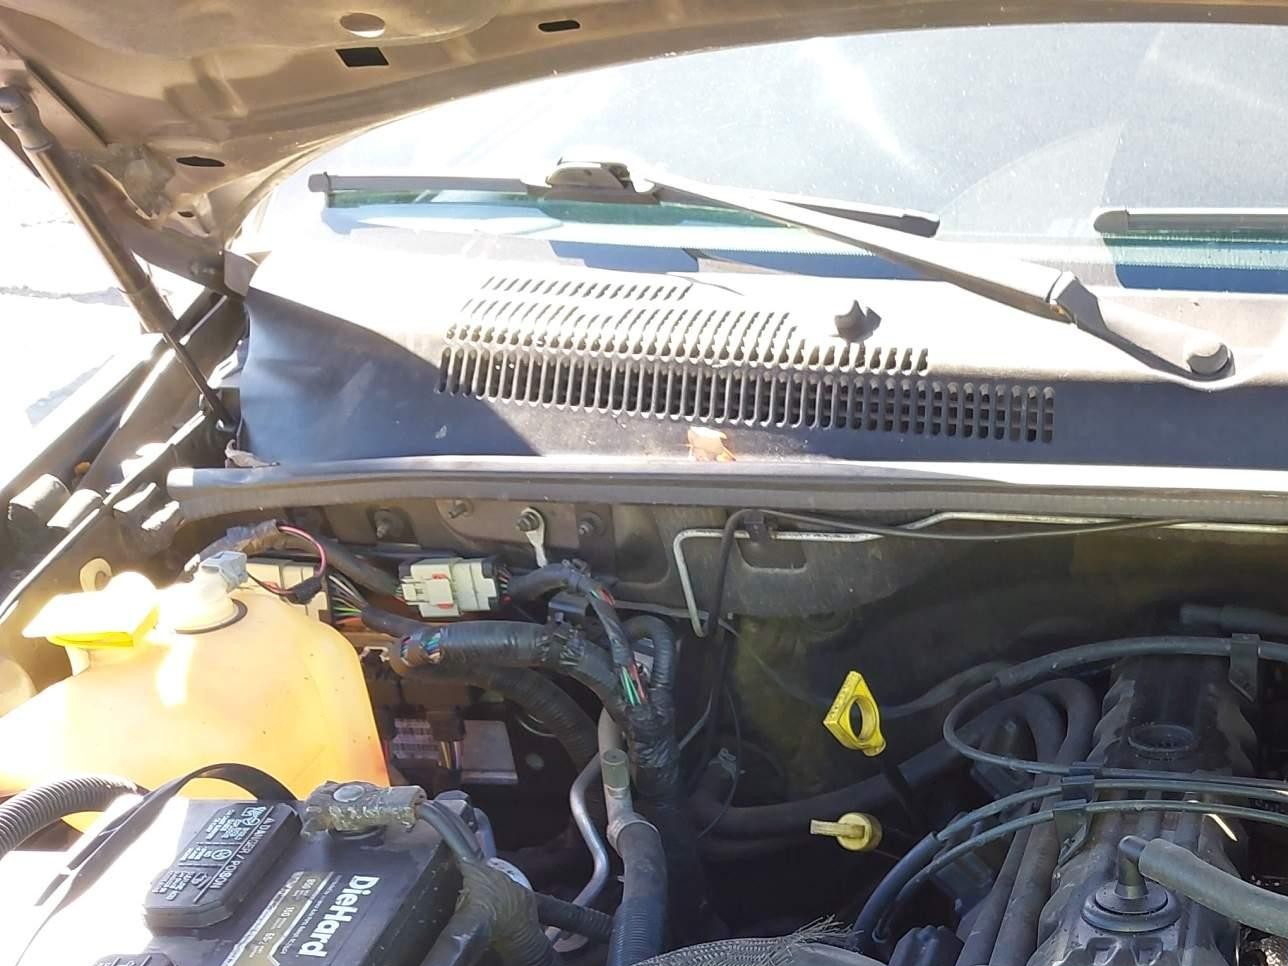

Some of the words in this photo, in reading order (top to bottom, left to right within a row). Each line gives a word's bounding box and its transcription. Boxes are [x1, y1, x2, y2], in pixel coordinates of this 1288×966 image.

[239, 824, 269, 854] DANGER
[209, 858, 242, 890] POISON
[298, 875, 381, 958] DieHard
